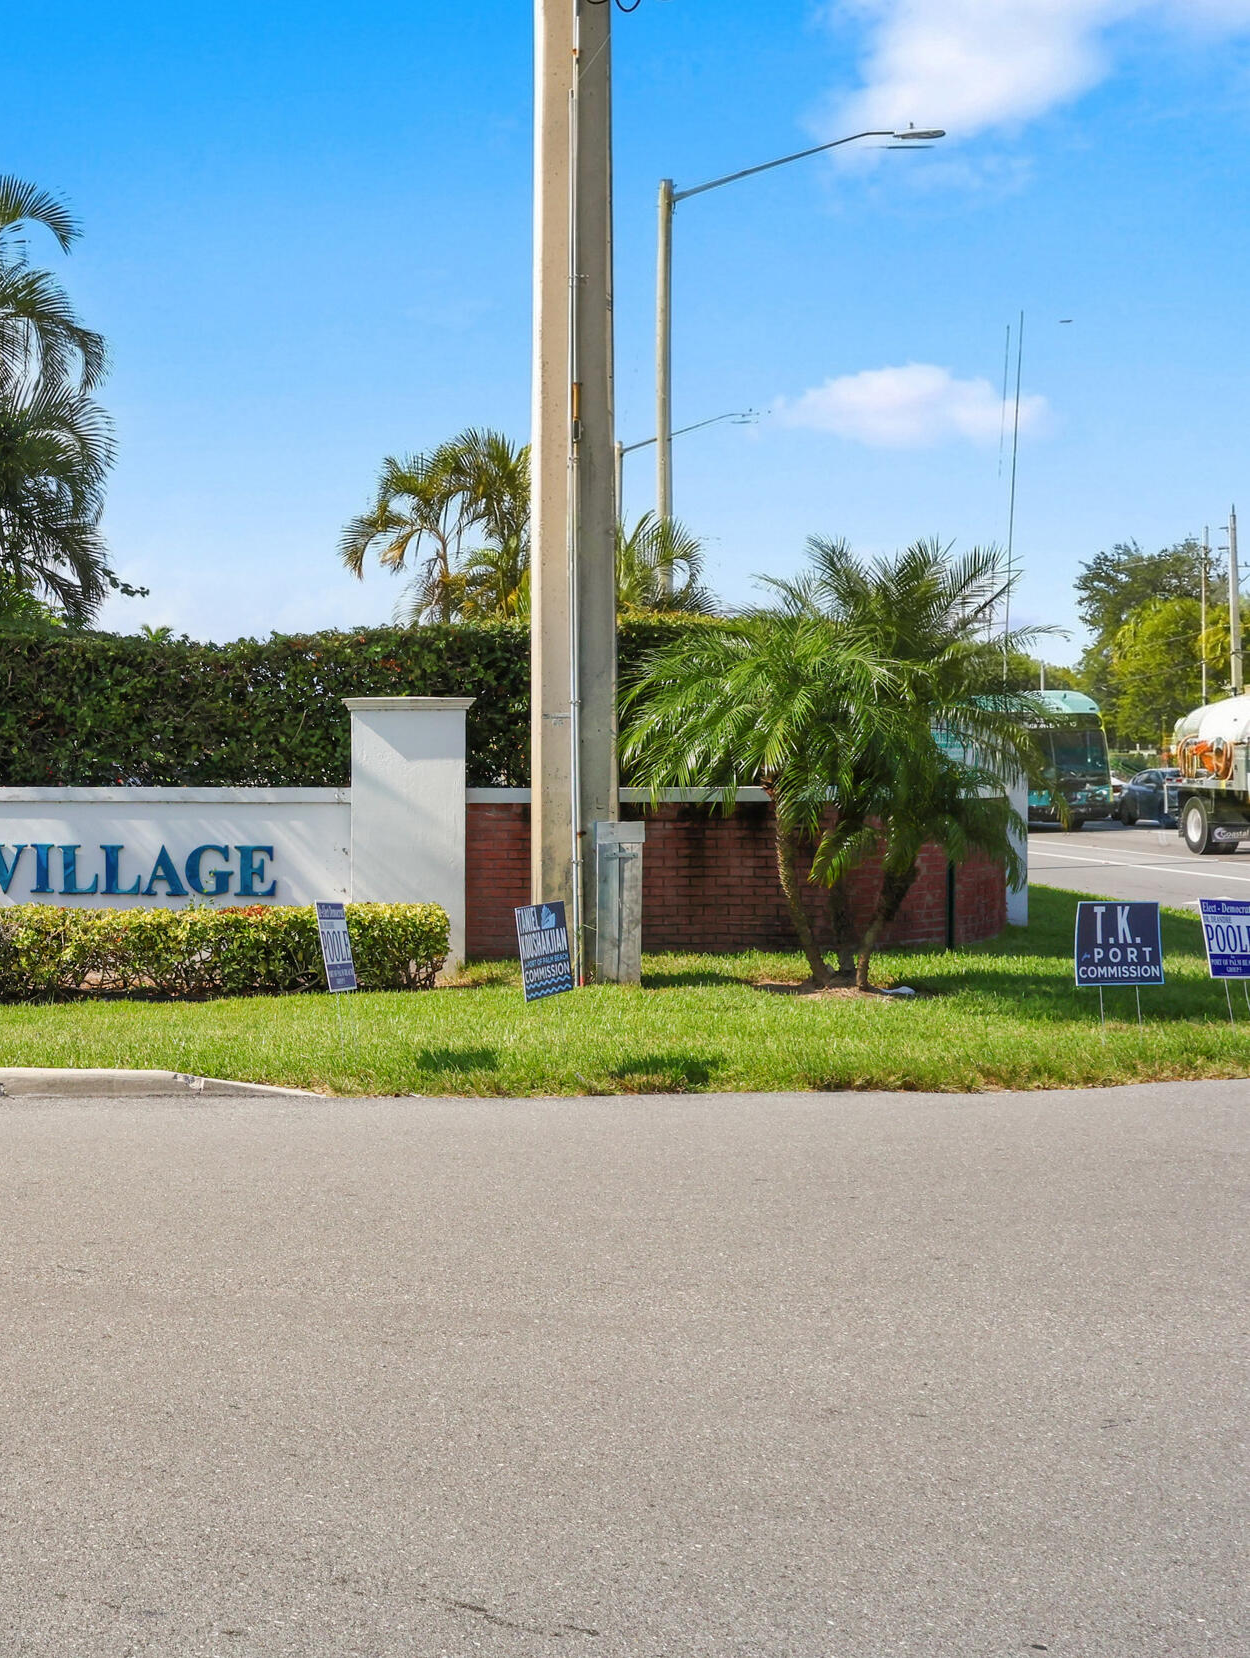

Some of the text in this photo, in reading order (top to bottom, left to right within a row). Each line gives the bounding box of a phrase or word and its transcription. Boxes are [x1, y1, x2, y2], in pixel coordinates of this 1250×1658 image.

[1202, 901, 1216, 913] Elect
[1093, 905, 1142, 944] T.K.
[321, 930, 352, 963] POOLE
[1093, 947, 1152, 963] PORT
[525, 961, 571, 984] COMMISSION
[1078, 965, 1160, 978] COMMISSION
